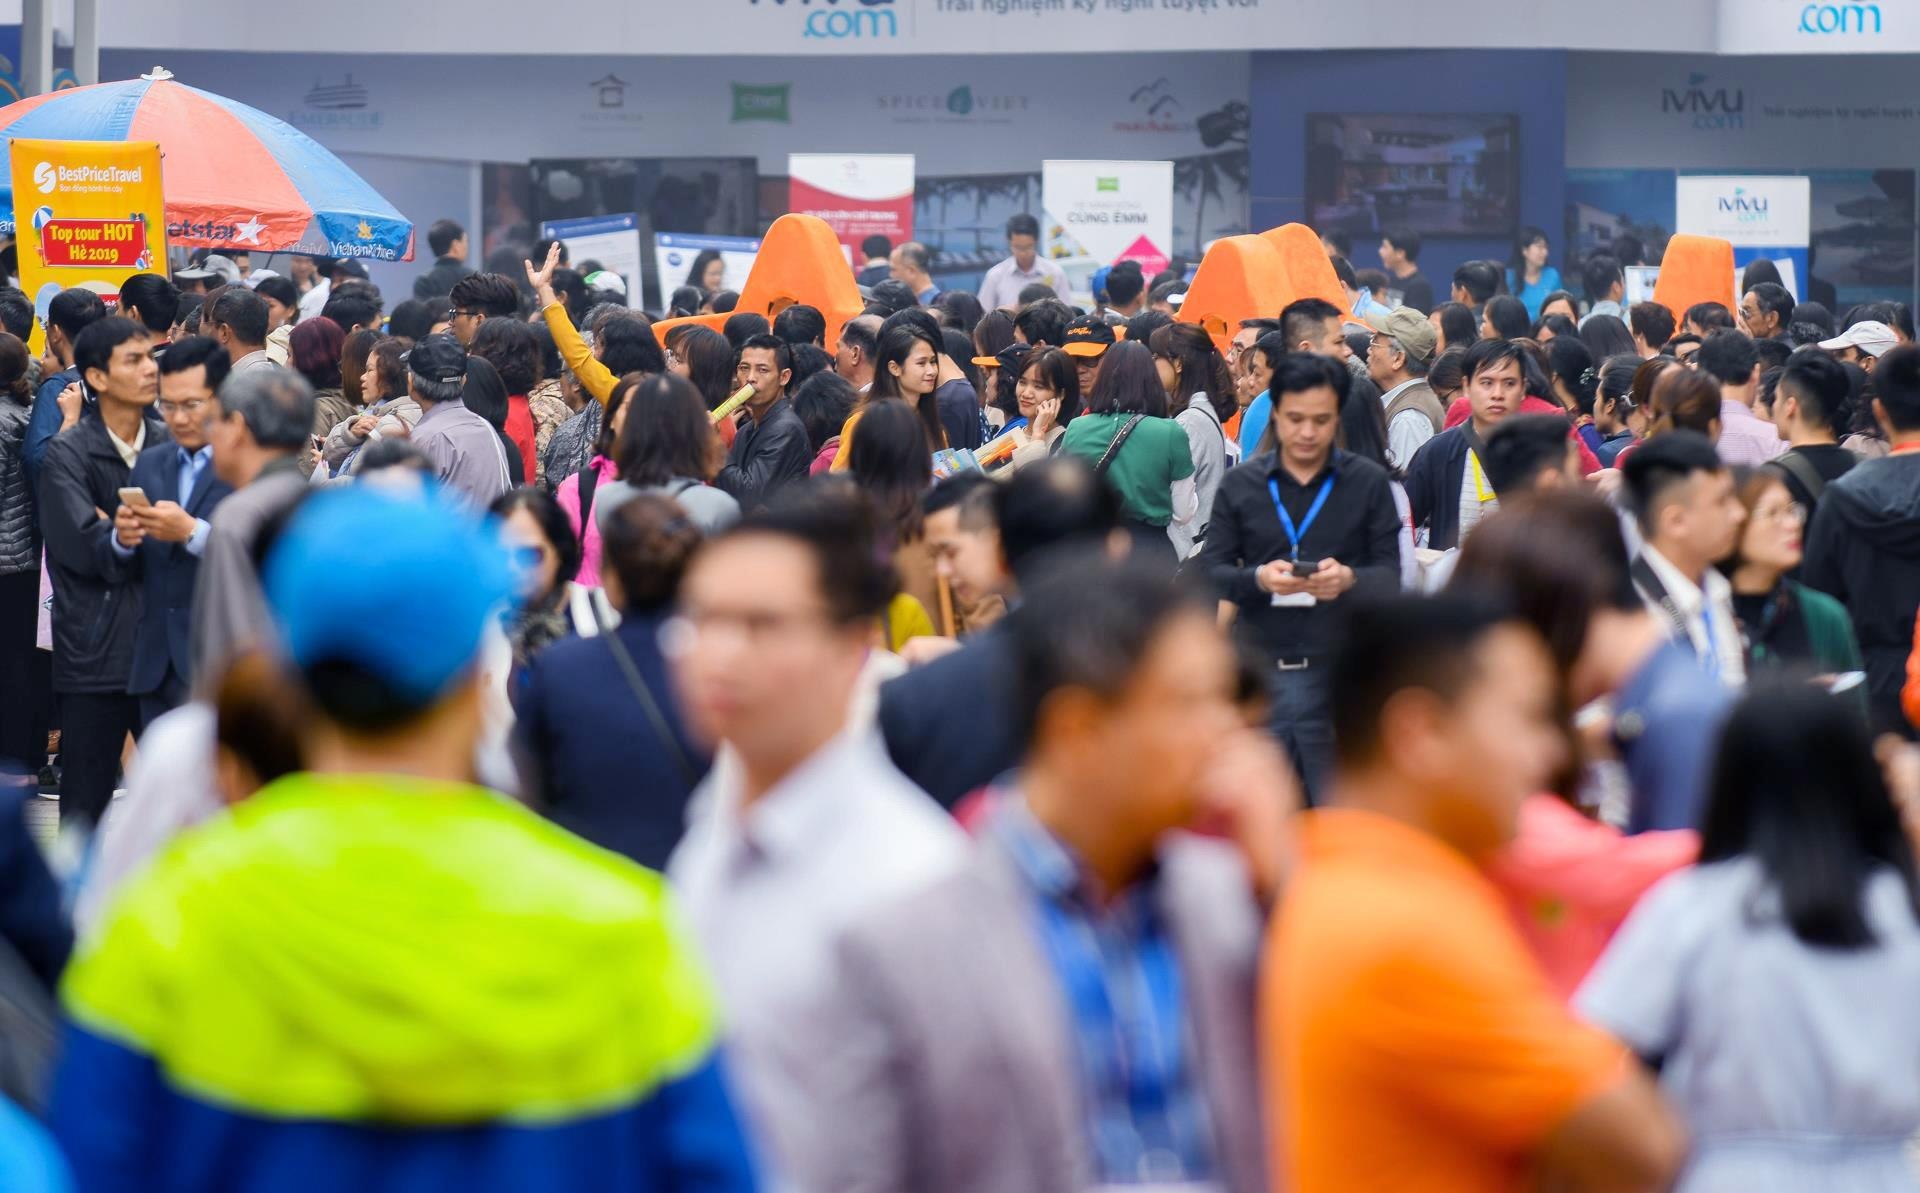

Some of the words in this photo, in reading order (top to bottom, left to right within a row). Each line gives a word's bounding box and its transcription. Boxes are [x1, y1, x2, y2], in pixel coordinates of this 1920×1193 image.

[803, 9, 897, 37] .com
[1797, 4, 1882, 34] .com
[59, 165, 142, 183] BestPriceTravel
[49, 225, 73, 243] Top
[75, 226, 102, 241] tour
[103, 223, 135, 241] HOT
[168, 219, 236, 241] etstar
[69, 243, 88, 260] Hè
[88, 247, 119, 264] 2019
